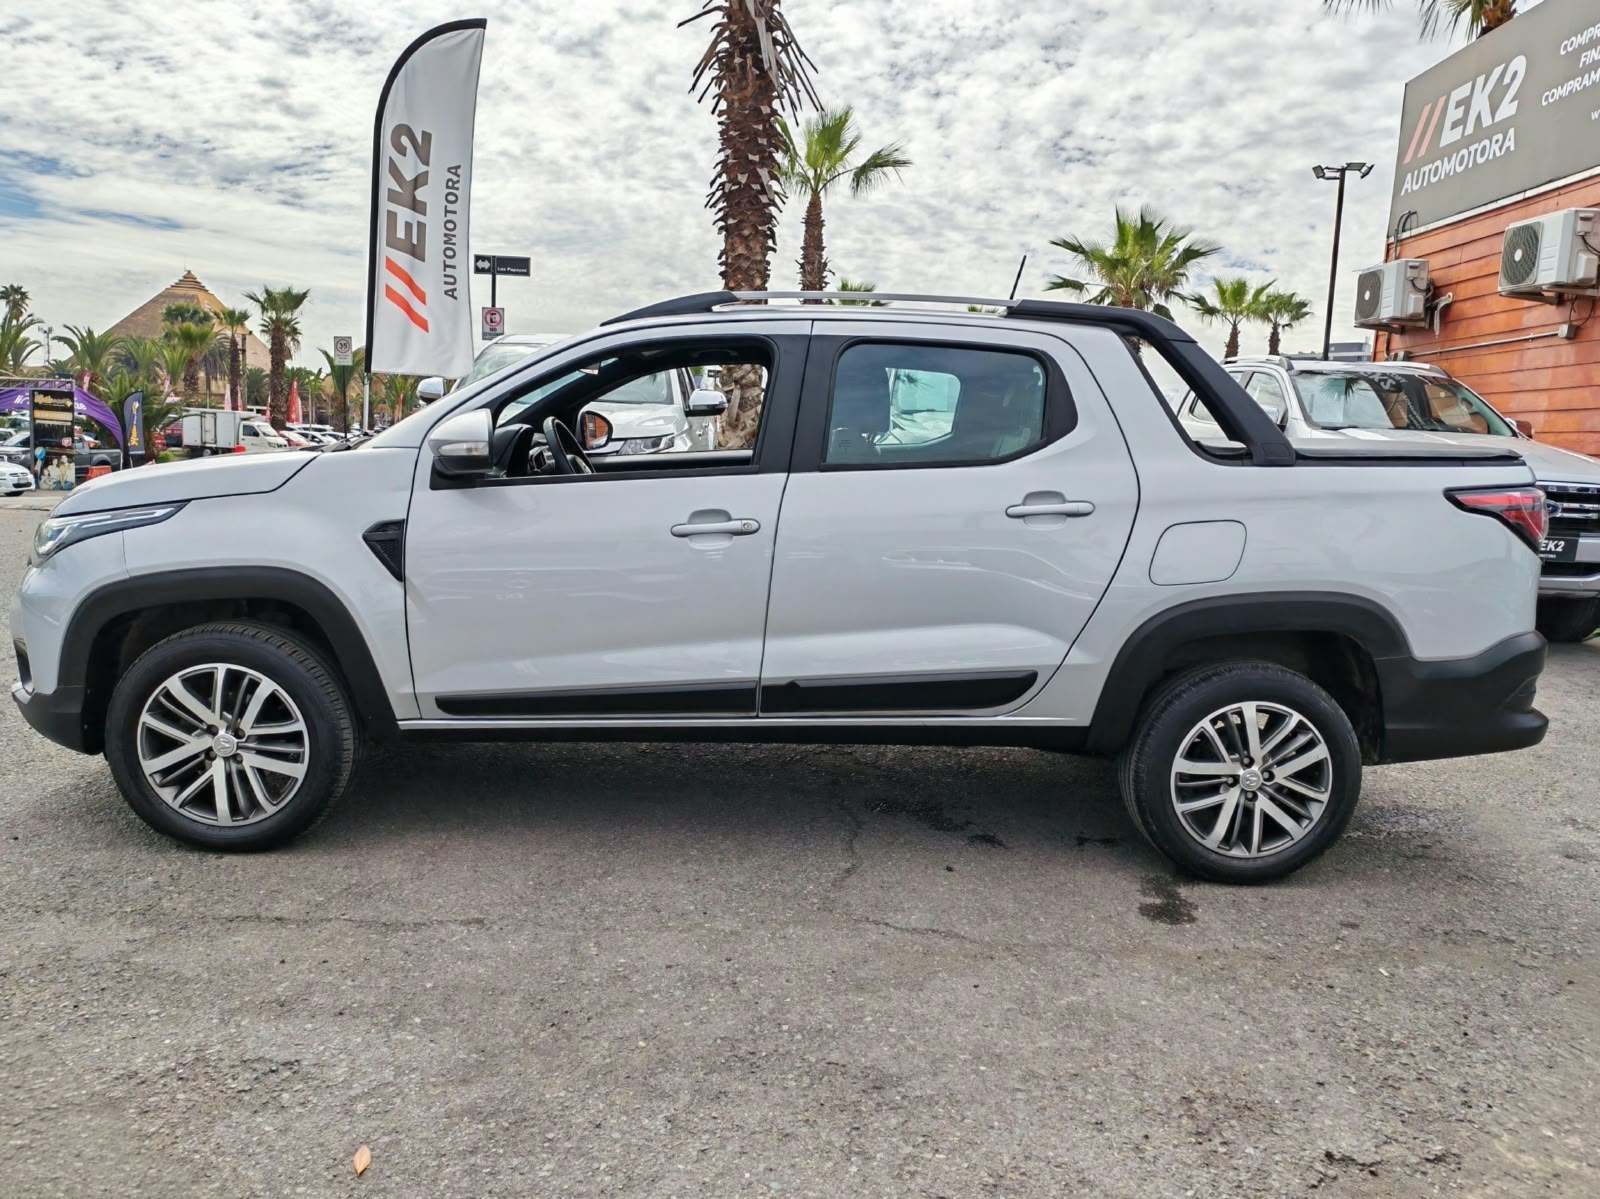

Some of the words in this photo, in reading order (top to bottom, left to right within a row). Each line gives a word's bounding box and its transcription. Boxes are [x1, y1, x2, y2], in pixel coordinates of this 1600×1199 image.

[1560, 23, 1600, 55] COMPR
[1440, 55, 1527, 148] EK2
[1541, 67, 1600, 106] COMPRAM
[1401, 128, 1515, 196] AUTOMOTORA
[385, 123, 432, 263] EK2
[443, 164, 461, 300] AUTOMOTORA
[339, 342, 348, 350] 35
[1540, 540, 1565, 552] EK2
